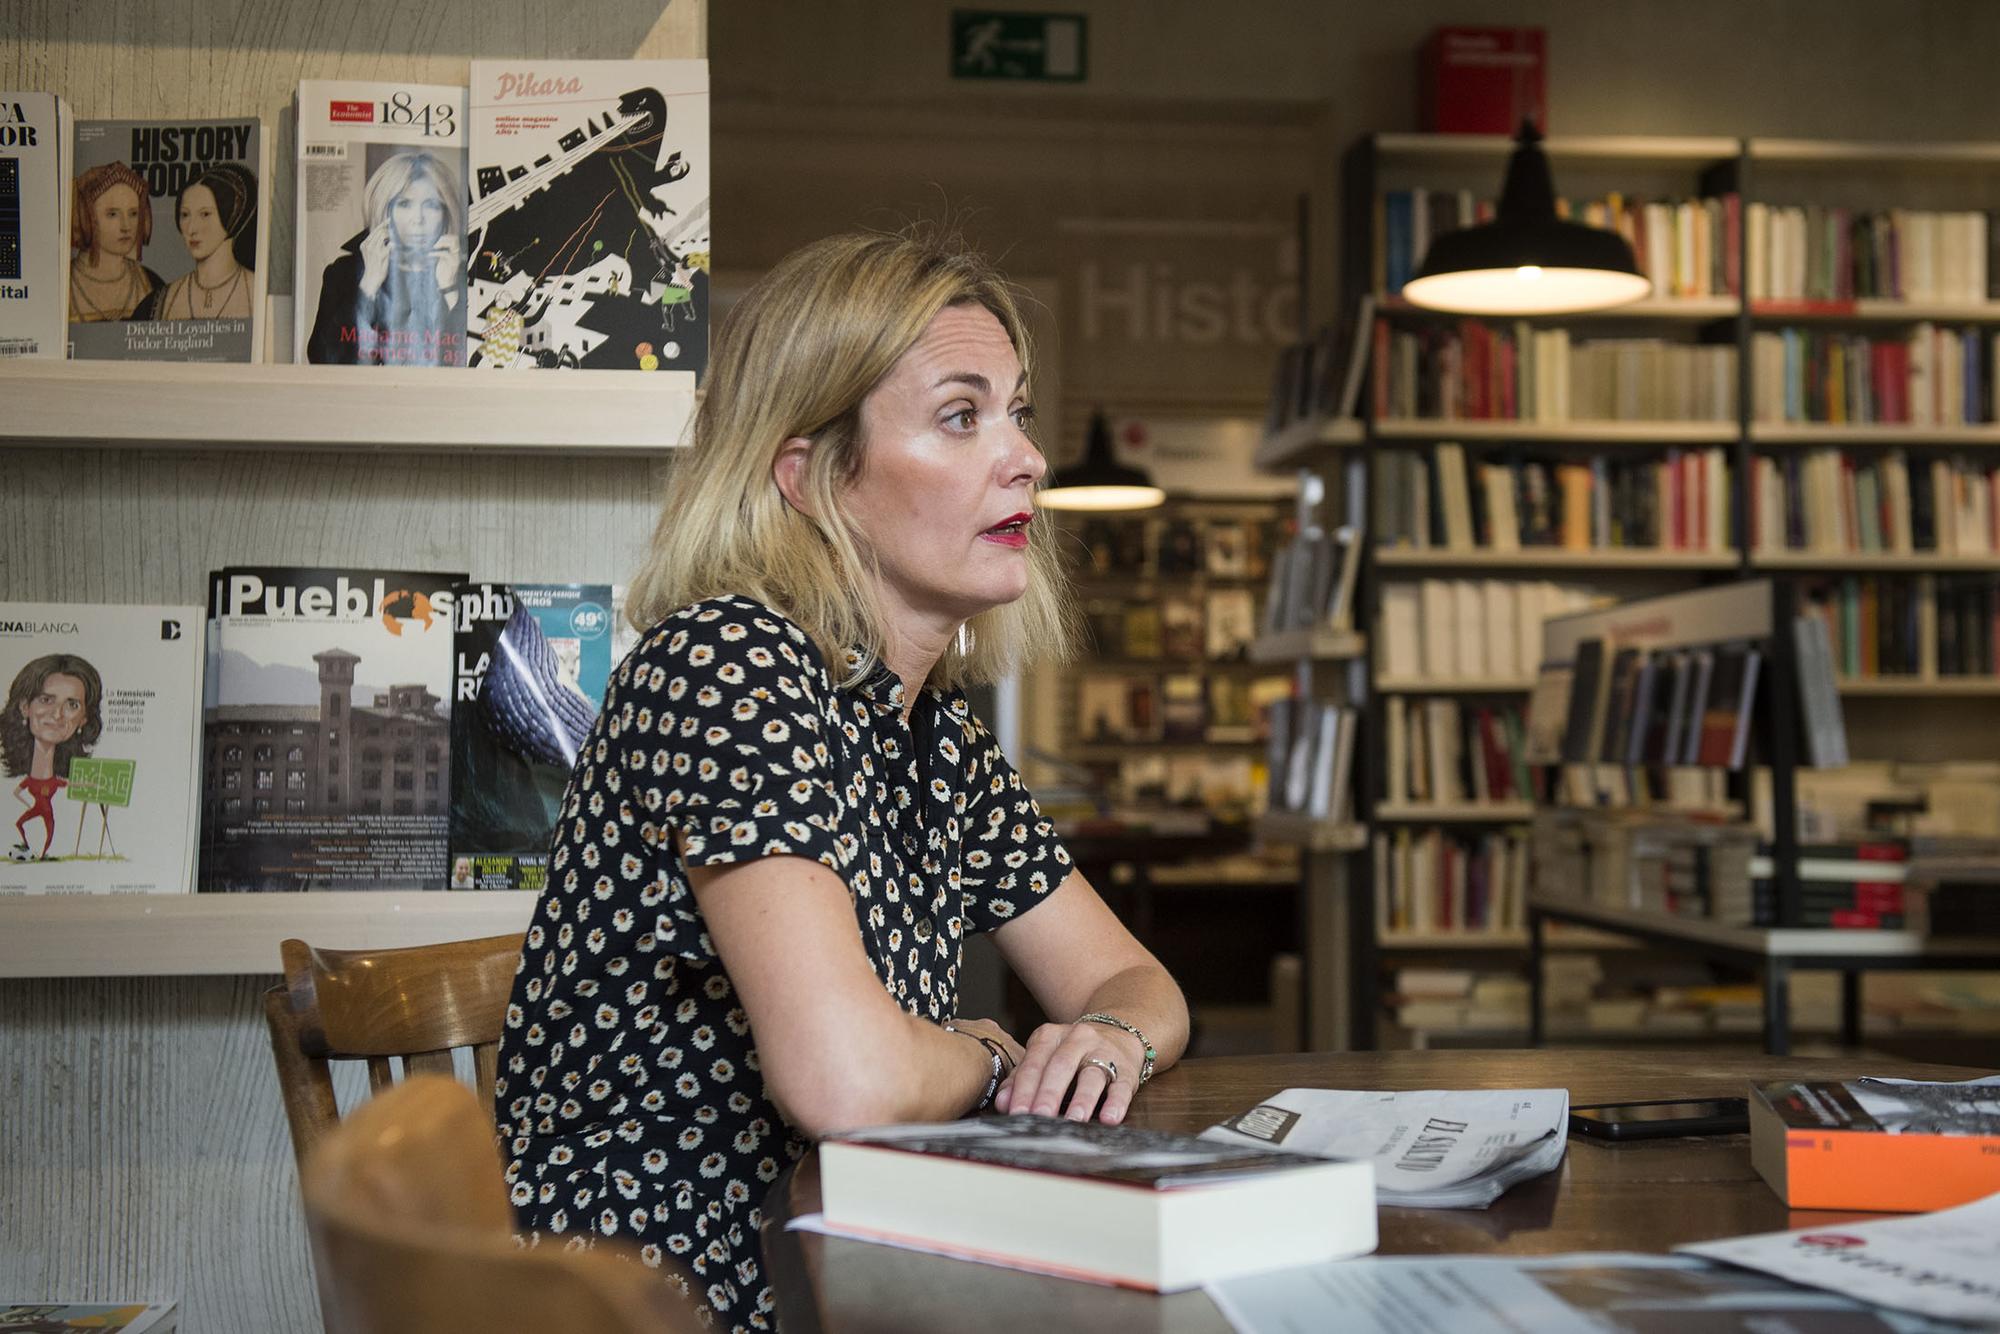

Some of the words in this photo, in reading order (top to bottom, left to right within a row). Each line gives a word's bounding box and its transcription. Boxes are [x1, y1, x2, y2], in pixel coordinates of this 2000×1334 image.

[494, 72, 583, 100] Pikara
[380, 91, 456, 137] 1843
[132, 125, 251, 162] HISTORY
[126, 322, 174, 336] Divided
[179, 321, 231, 337] Loyalties
[233, 321, 245, 333] in
[340, 326, 419, 342] Madame
[125, 337, 162, 350] Tudor
[165, 336, 213, 351] England
[117, 689, 155, 697] transición
[108, 699, 145, 709] ecológica
[109, 708, 144, 717] explicada
[108, 718, 125, 726] para
[127, 716, 144, 724] todo
[115, 725, 142, 733] mundo
[476, 856, 513, 865] ALEXANDRE
